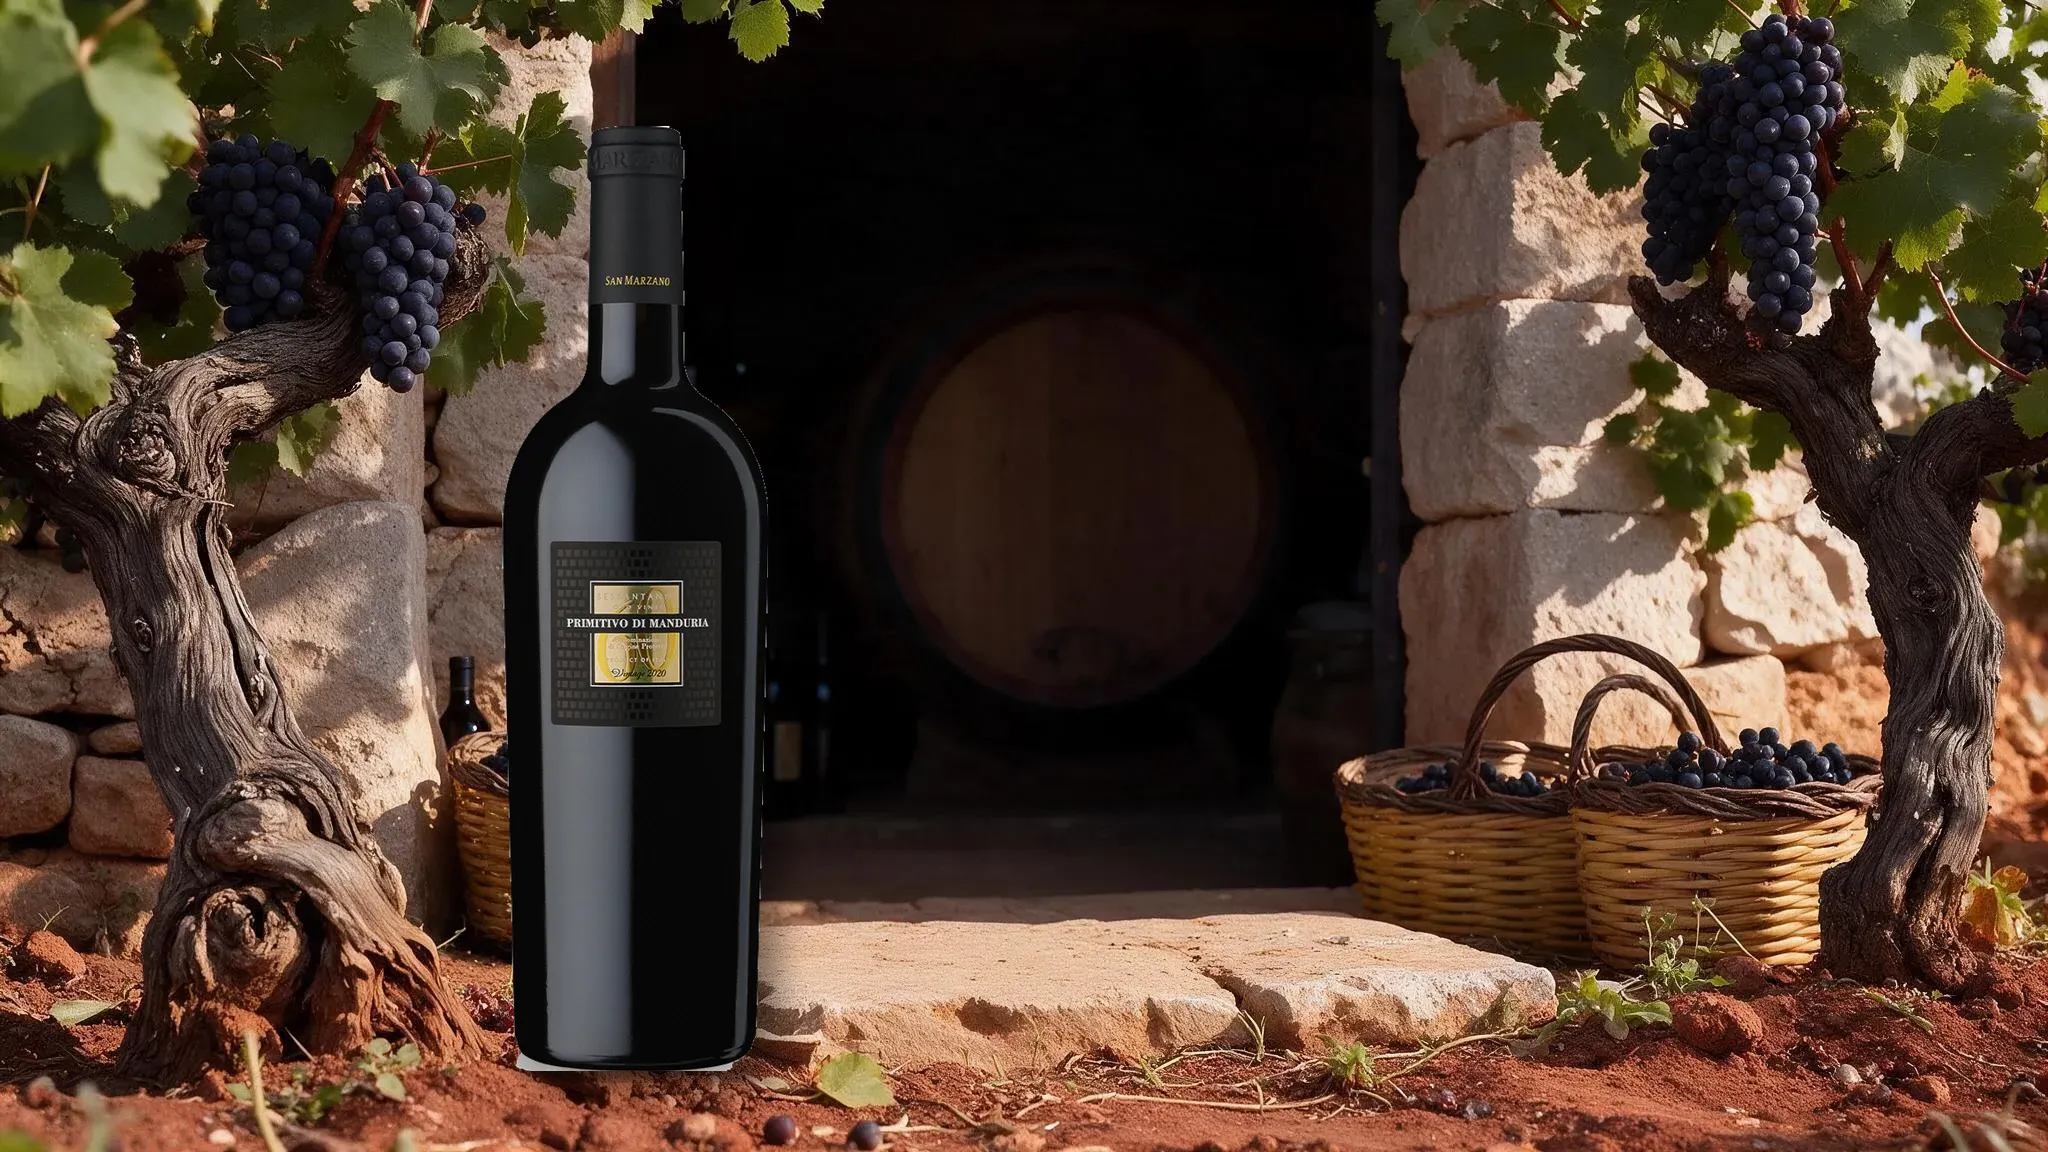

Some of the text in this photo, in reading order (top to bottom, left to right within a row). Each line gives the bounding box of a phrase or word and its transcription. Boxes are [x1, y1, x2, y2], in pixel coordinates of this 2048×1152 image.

[624, 274, 671, 286] MARZANO
[567, 617, 709, 628] PRIMITIVO DI MANDURIA
[647, 668, 667, 678] 2020
